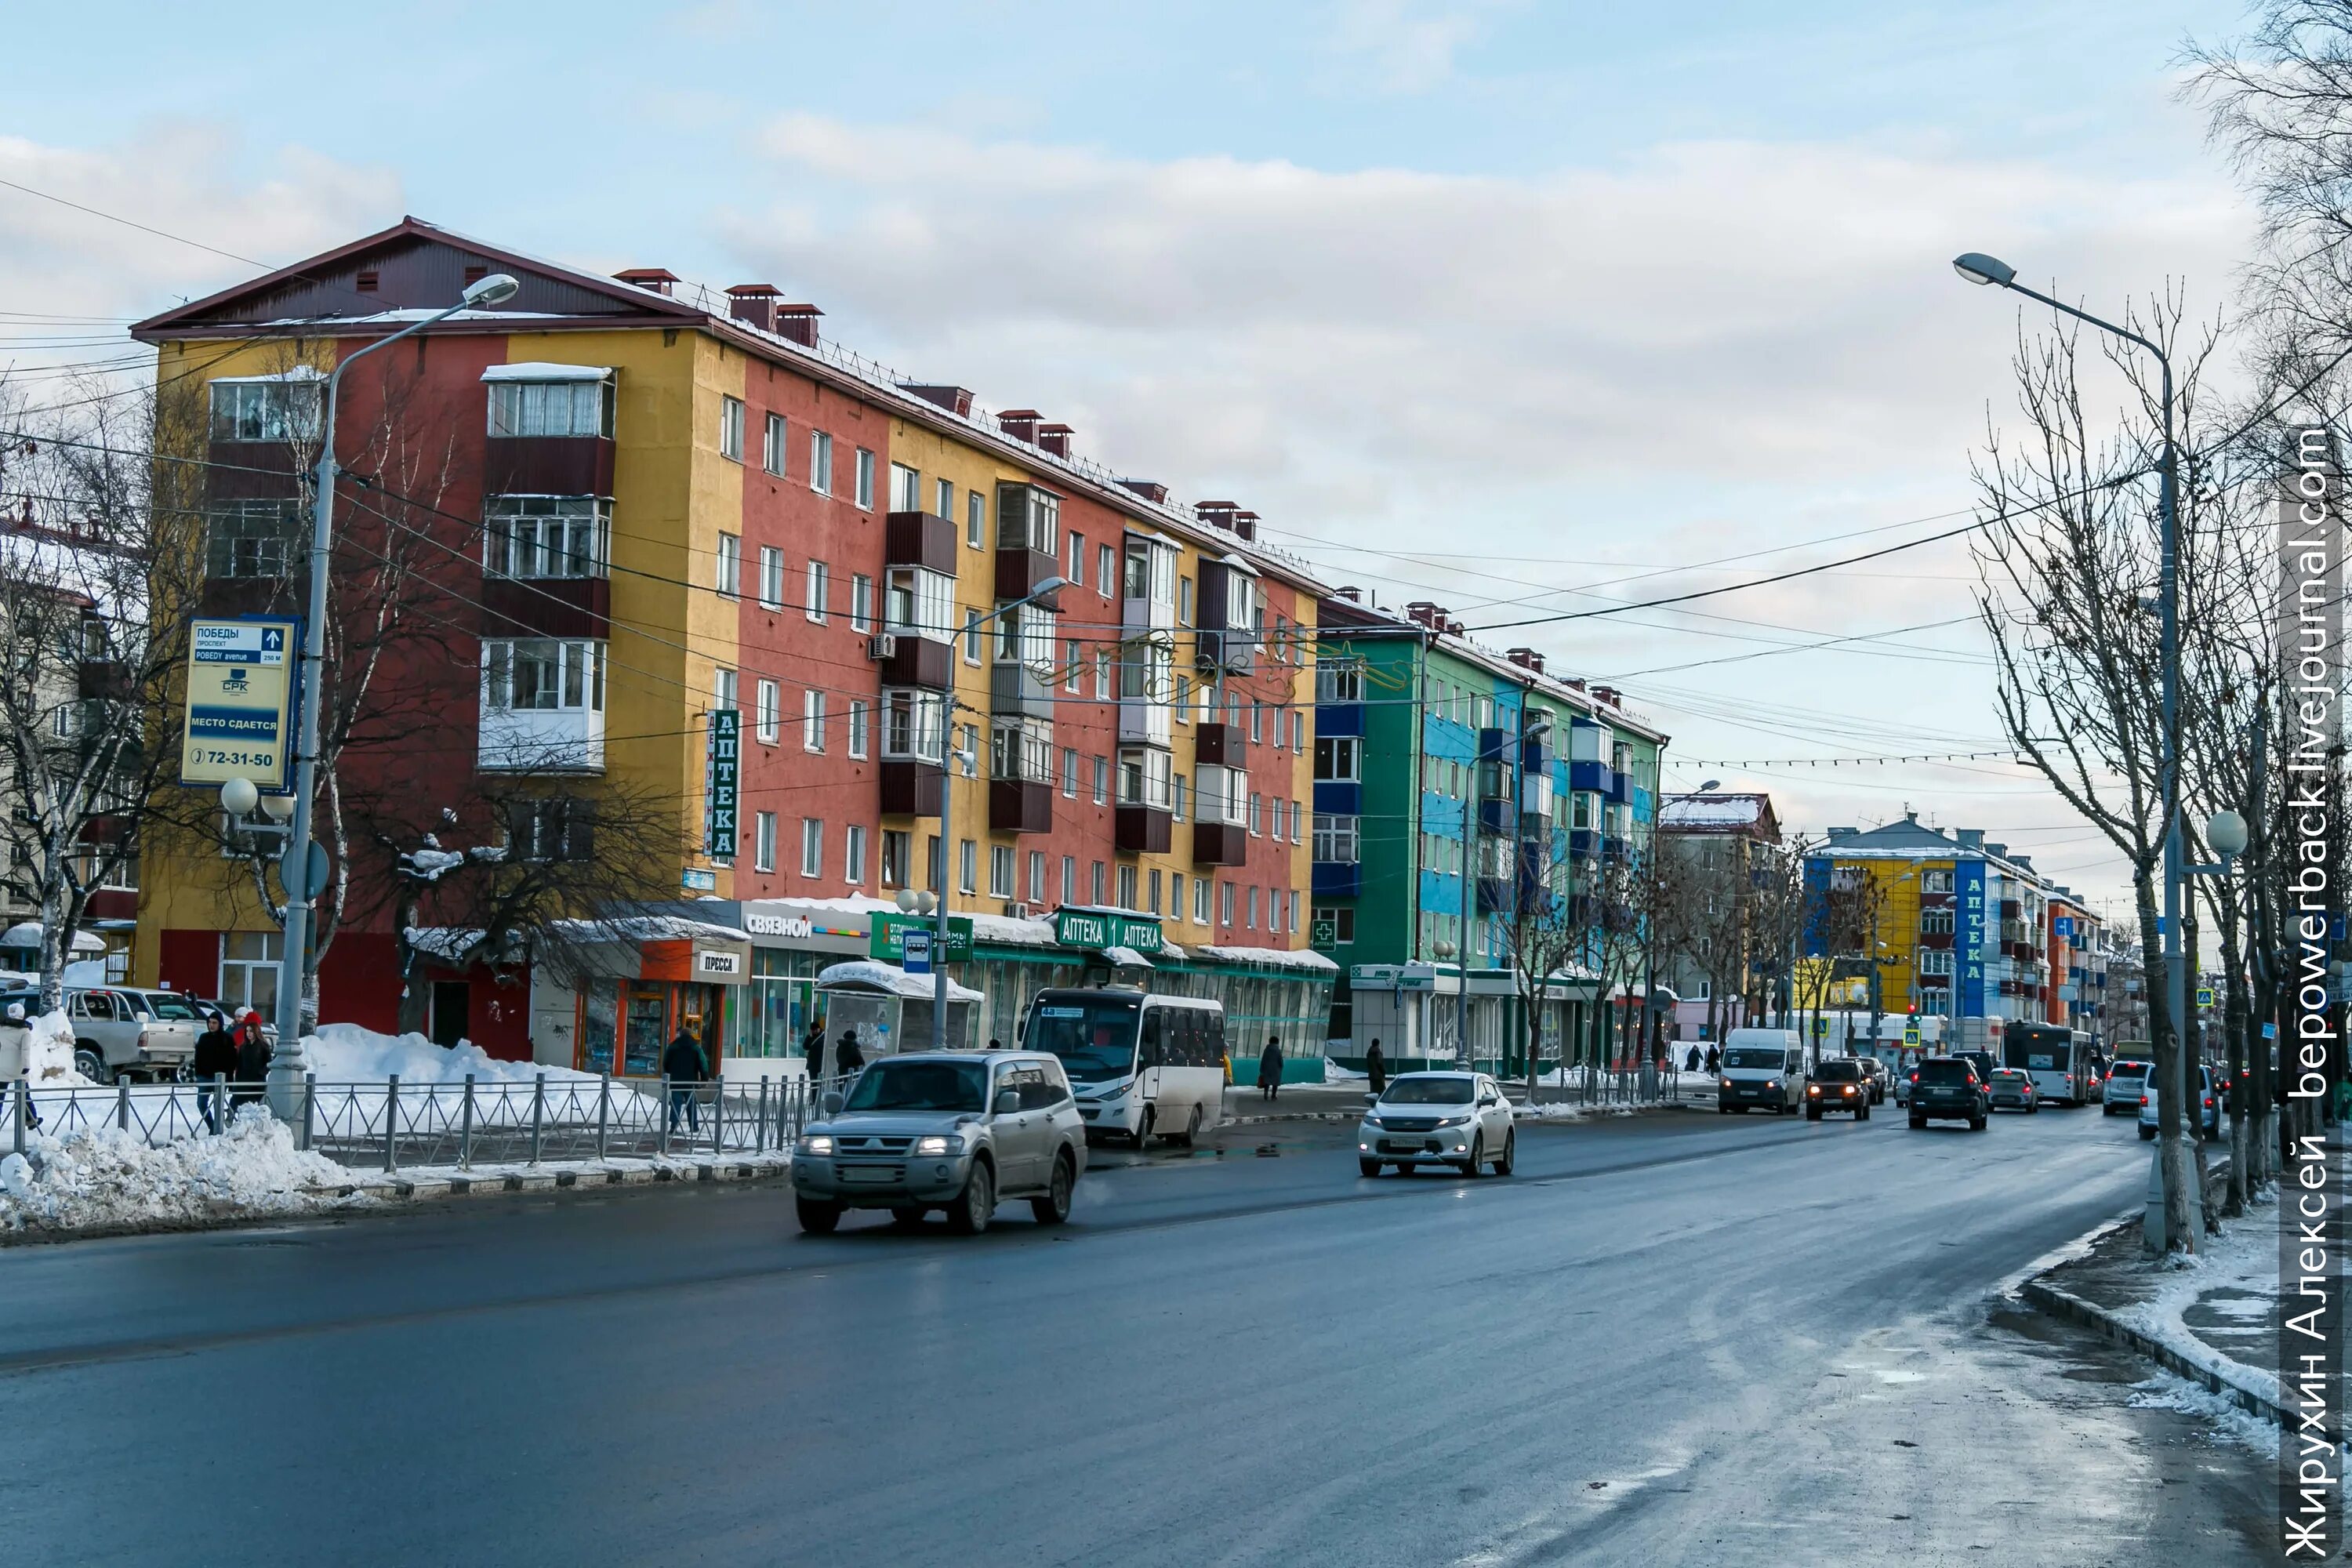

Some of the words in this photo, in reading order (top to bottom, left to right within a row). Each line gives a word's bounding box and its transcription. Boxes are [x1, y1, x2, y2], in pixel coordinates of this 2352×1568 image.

[197, 628, 238, 639] ПОБЕДЫ
[196, 652, 222, 660] POBEDY
[191, 717, 226, 728] МЕСТО
[228, 719, 277, 731] СДАЕТСЯ
[208, 750, 273, 766] 72-31-50
[714, 716, 736, 852] АПТЕКА
[745, 913, 812, 938] СВЯЗНОЙ
[1063, 916, 1103, 944] АПТЕКА
[1123, 924, 1159, 948] АПТЕКА
[1967, 879, 1981, 978] АПТЕКА
[705, 956, 732, 972] ПРЕССА
